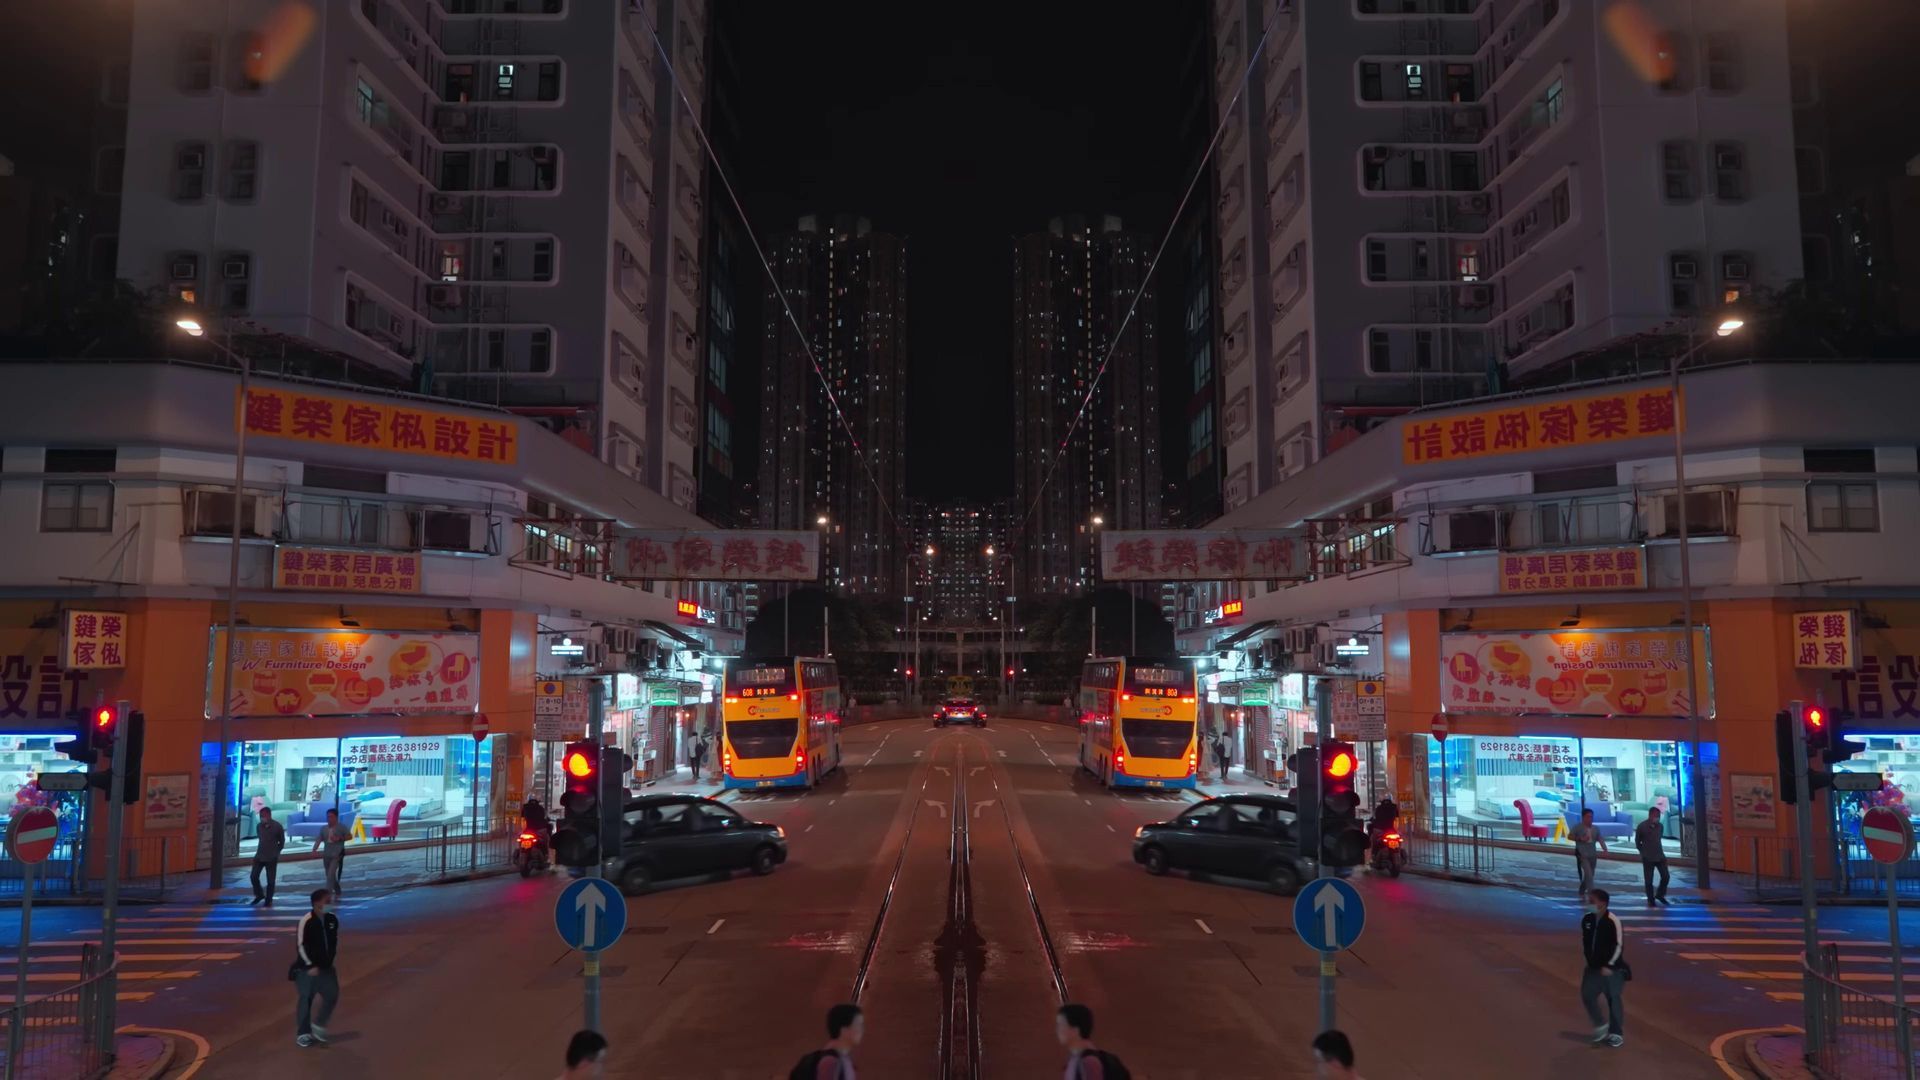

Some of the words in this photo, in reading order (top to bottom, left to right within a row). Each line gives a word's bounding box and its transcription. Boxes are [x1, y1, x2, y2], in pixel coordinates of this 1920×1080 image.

[246, 391, 513, 460] 鍵榮傢俬設計
[283, 552, 415, 575] 鍵榮家居廣場
[265, 660, 325, 670] Furniture
[326, 661, 366, 671] Design
